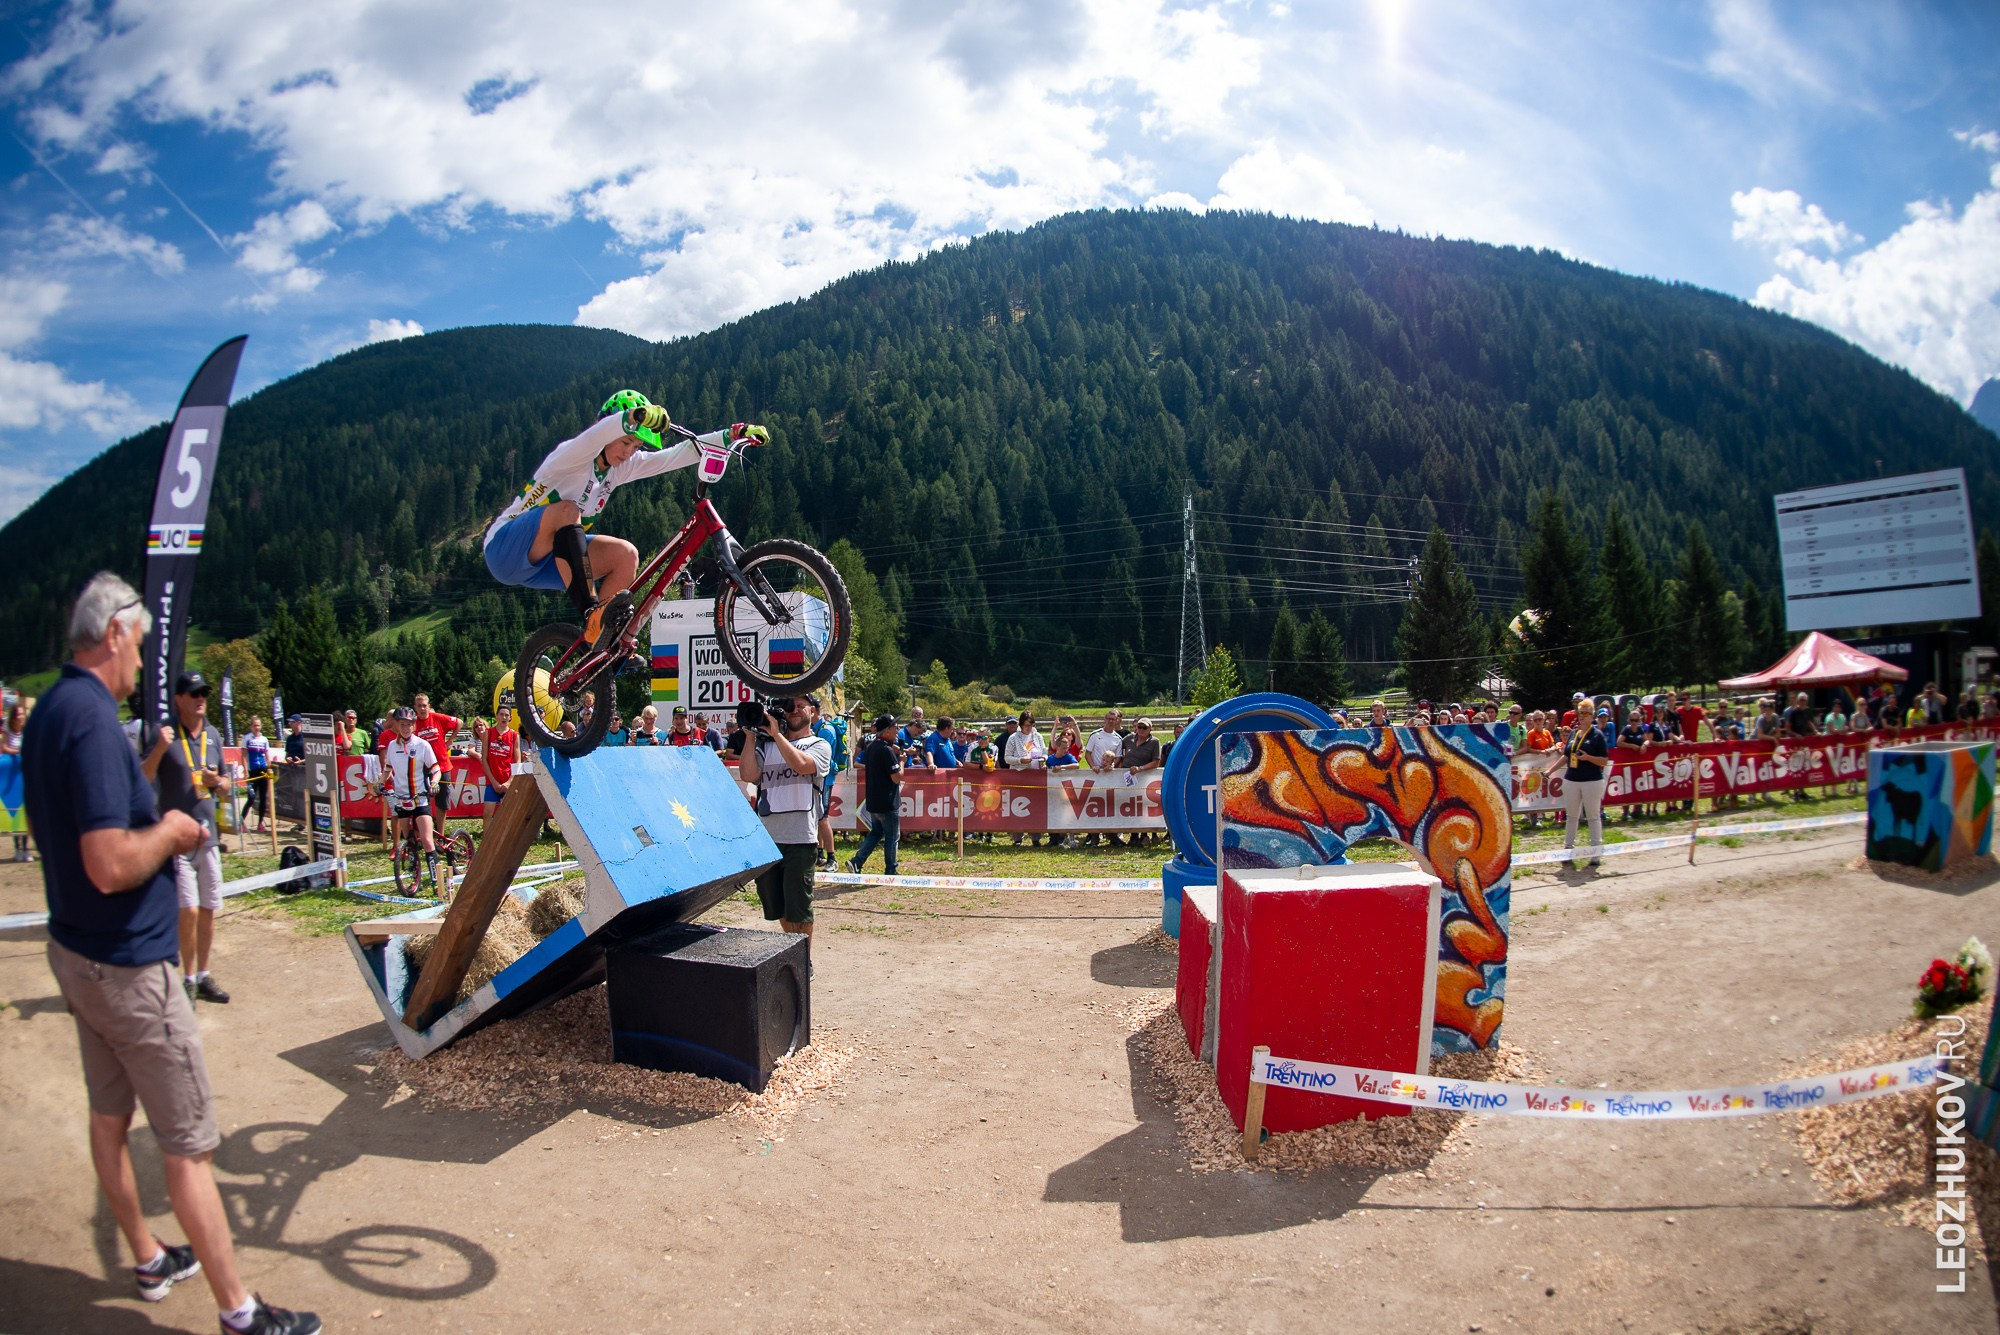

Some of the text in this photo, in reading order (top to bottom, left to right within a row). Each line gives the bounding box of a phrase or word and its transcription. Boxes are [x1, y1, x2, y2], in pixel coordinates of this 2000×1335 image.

[171, 429, 208, 508] 5
[161, 530, 187, 548] UCI
[695, 639, 705, 647] UCI
[500, 694, 515, 703] Meli
[698, 679, 750, 703] 2016
[711, 713, 722, 724] 4X
[305, 742, 333, 756] START
[761, 770, 774, 783] TV
[1635, 771, 1653, 792] di
[1717, 752, 1757, 789] Val
[1758, 761, 1773, 781] di
[1772, 745, 1823, 778] Sole
[1825, 743, 1857, 778] Val
[315, 763, 329, 794] 5
[927, 796, 950, 817] di
[1061, 779, 1115, 820] Val
[1120, 795, 1142, 817] di
[1265, 1062, 1336, 1088] TRENTINO
[1354, 1073, 1376, 1094] Val
[1378, 1084, 1390, 1096] di
[1391, 1079, 1427, 1101] Sole
[1437, 1085, 1507, 1110] TRENTINO
[1525, 1092, 1547, 1111] Val
[1549, 1101, 1559, 1112] di
[1560, 1095, 1595, 1113] Sole
[1605, 1098, 1672, 1117] TRENTINO
[1688, 1095, 1711, 1112] Val
[1722, 1094, 1754, 1112] Sole
[1763, 1085, 1825, 1110] TRENTINO
[1839, 1077, 1860, 1096] Val
